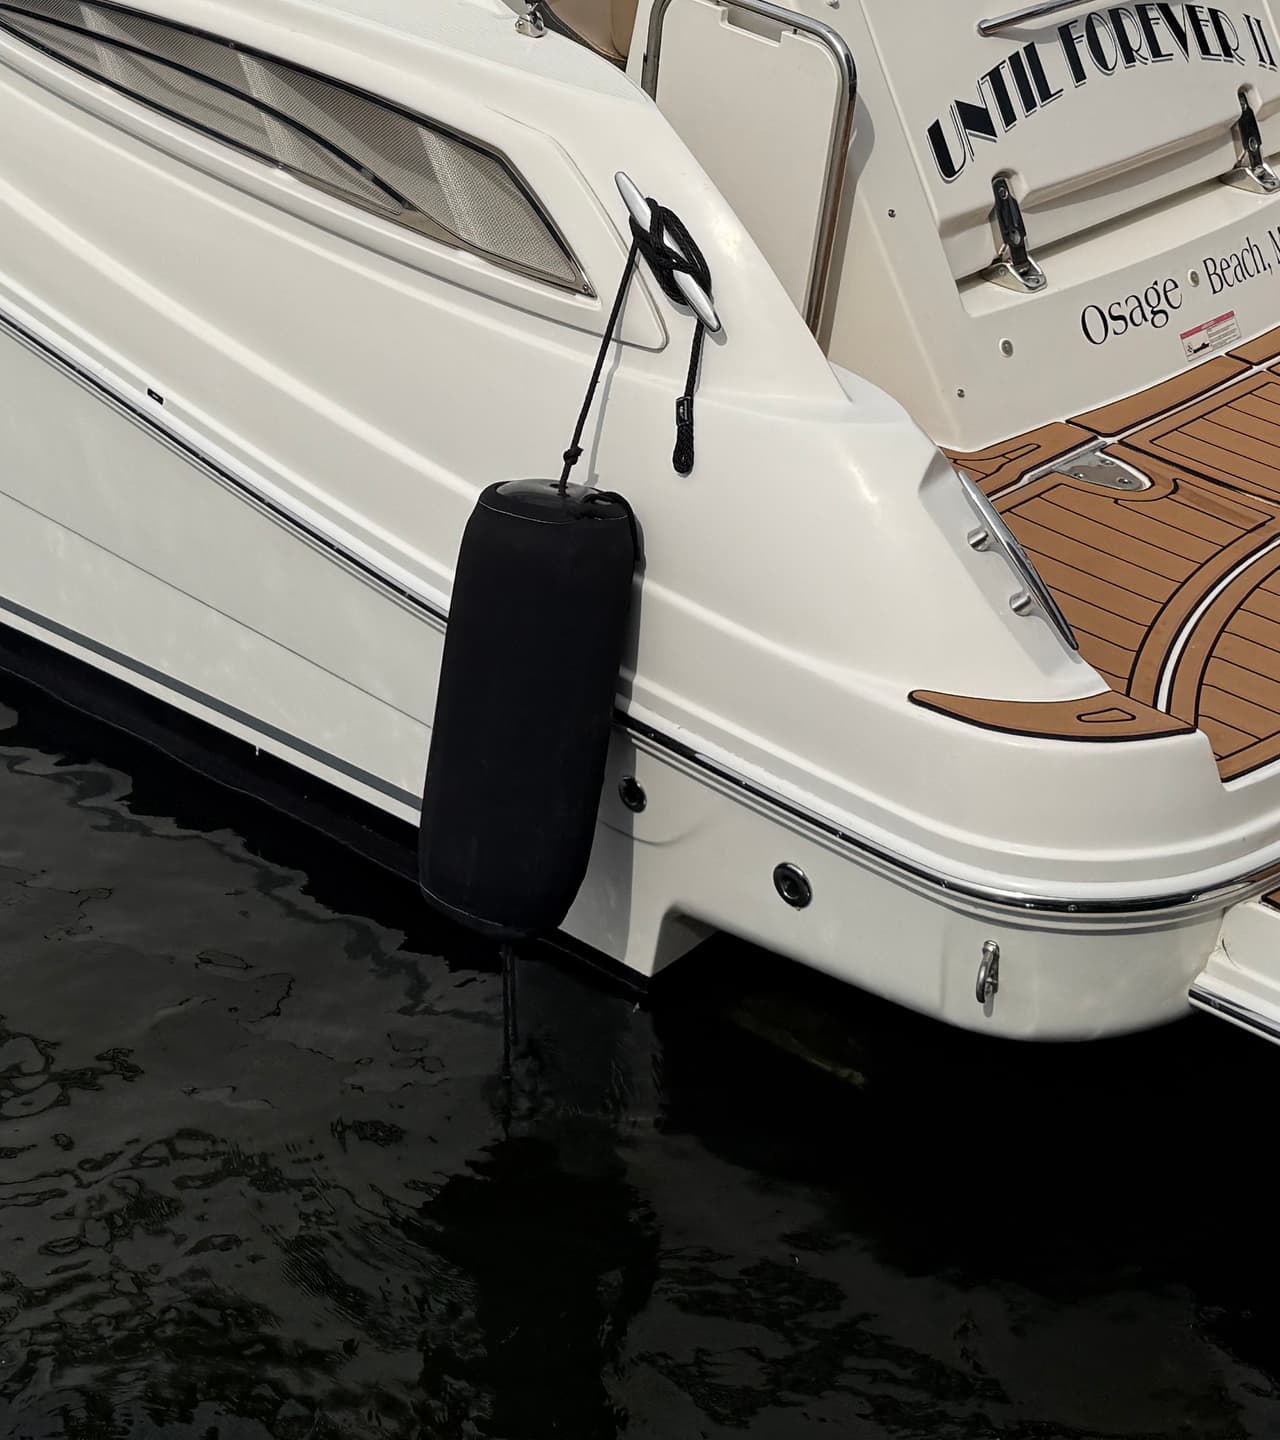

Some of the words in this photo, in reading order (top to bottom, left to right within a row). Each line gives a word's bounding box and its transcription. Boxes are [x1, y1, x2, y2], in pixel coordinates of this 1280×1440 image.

[926, 41, 1064, 184] UNTIL
[1057, 2, 1246, 88] FOREVER
[1242, 13, 1279, 72] II
[1080, 278, 1183, 345] Osage
[1202, 236, 1274, 295] Beach,
